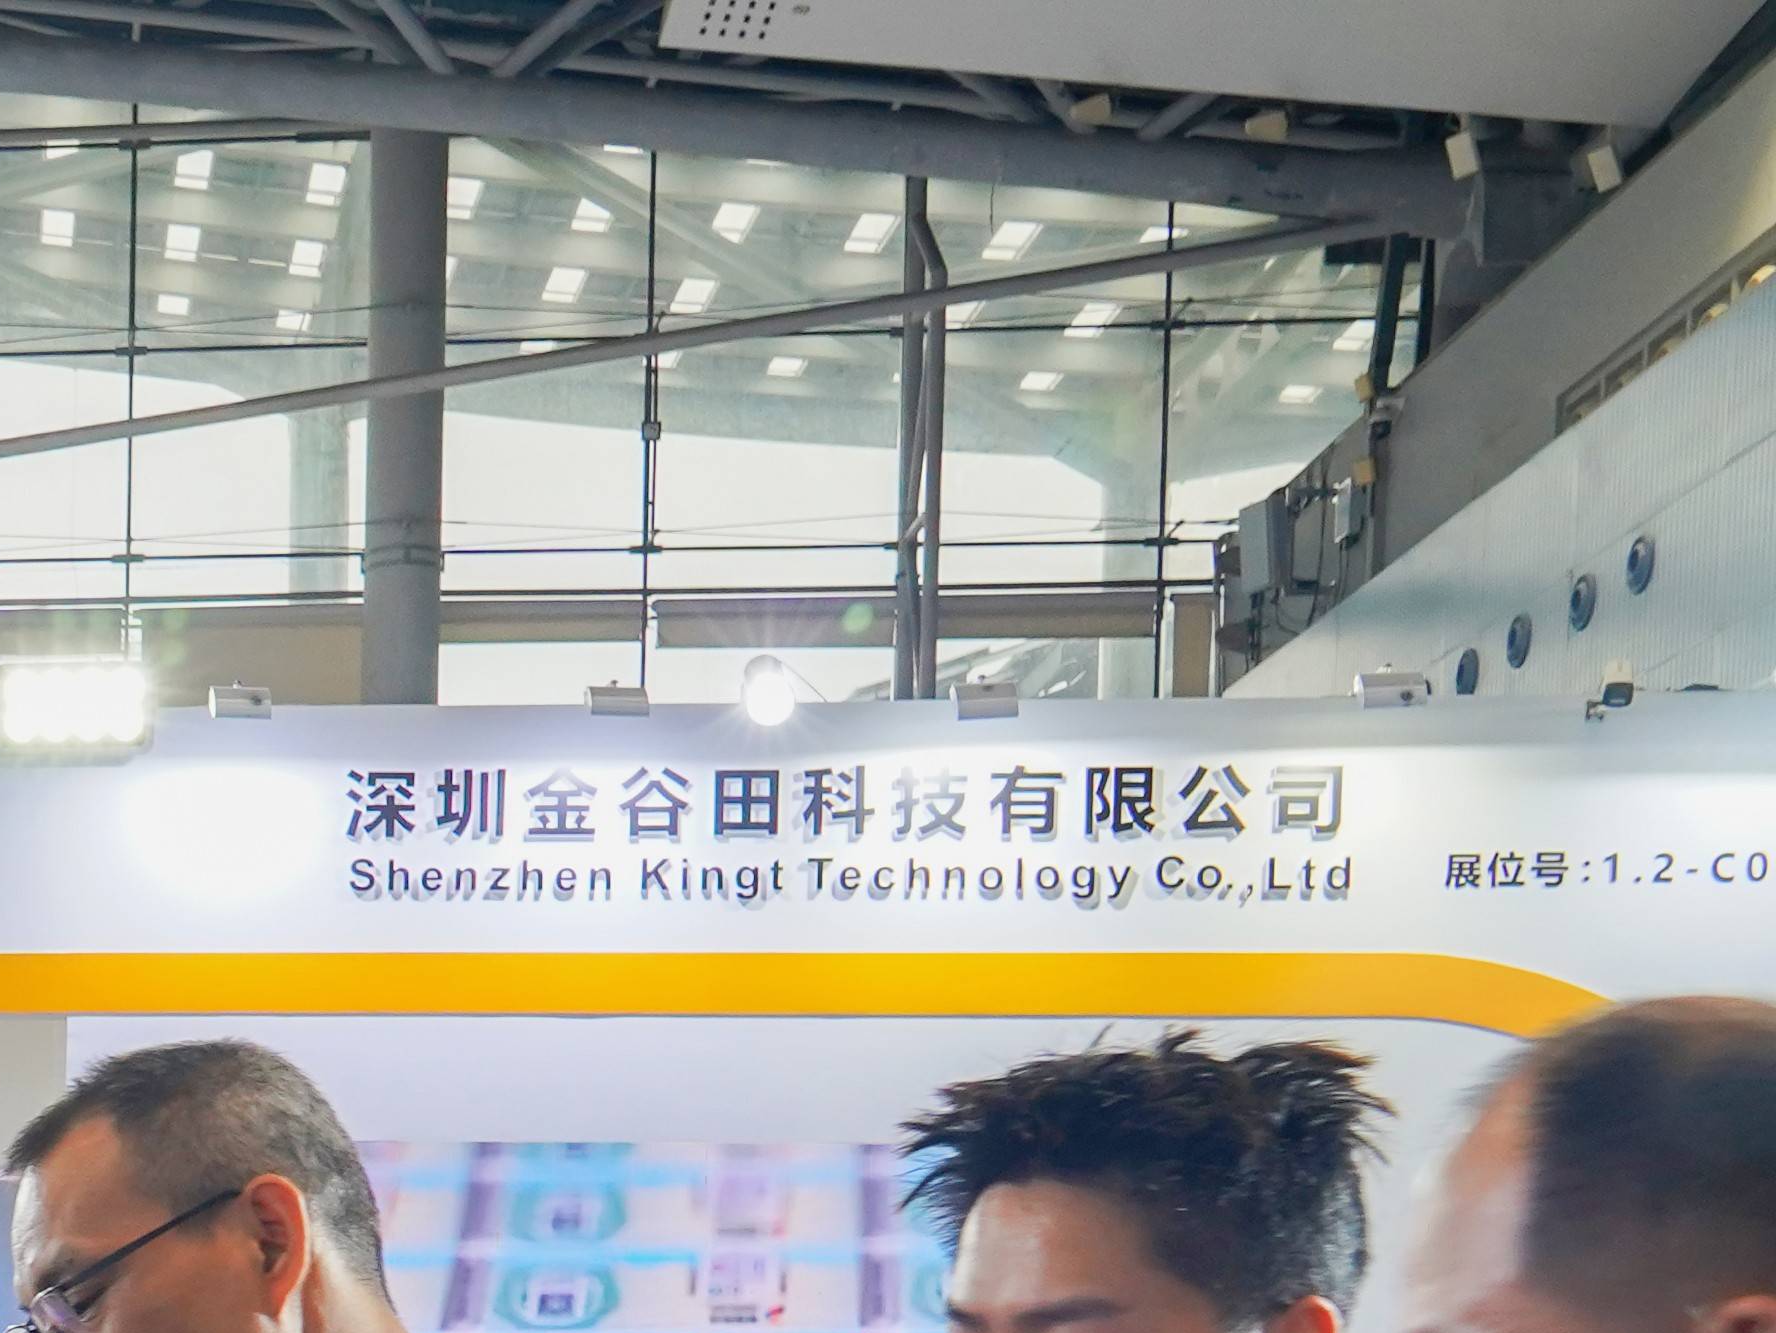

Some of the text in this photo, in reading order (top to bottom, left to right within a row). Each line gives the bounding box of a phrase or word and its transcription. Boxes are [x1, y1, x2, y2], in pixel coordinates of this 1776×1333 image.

[346, 765, 1345, 838] 深圳金谷田科技有限公司
[348, 854, 1352, 902] Shenzhen Kingt Technology Co.,Ltd
